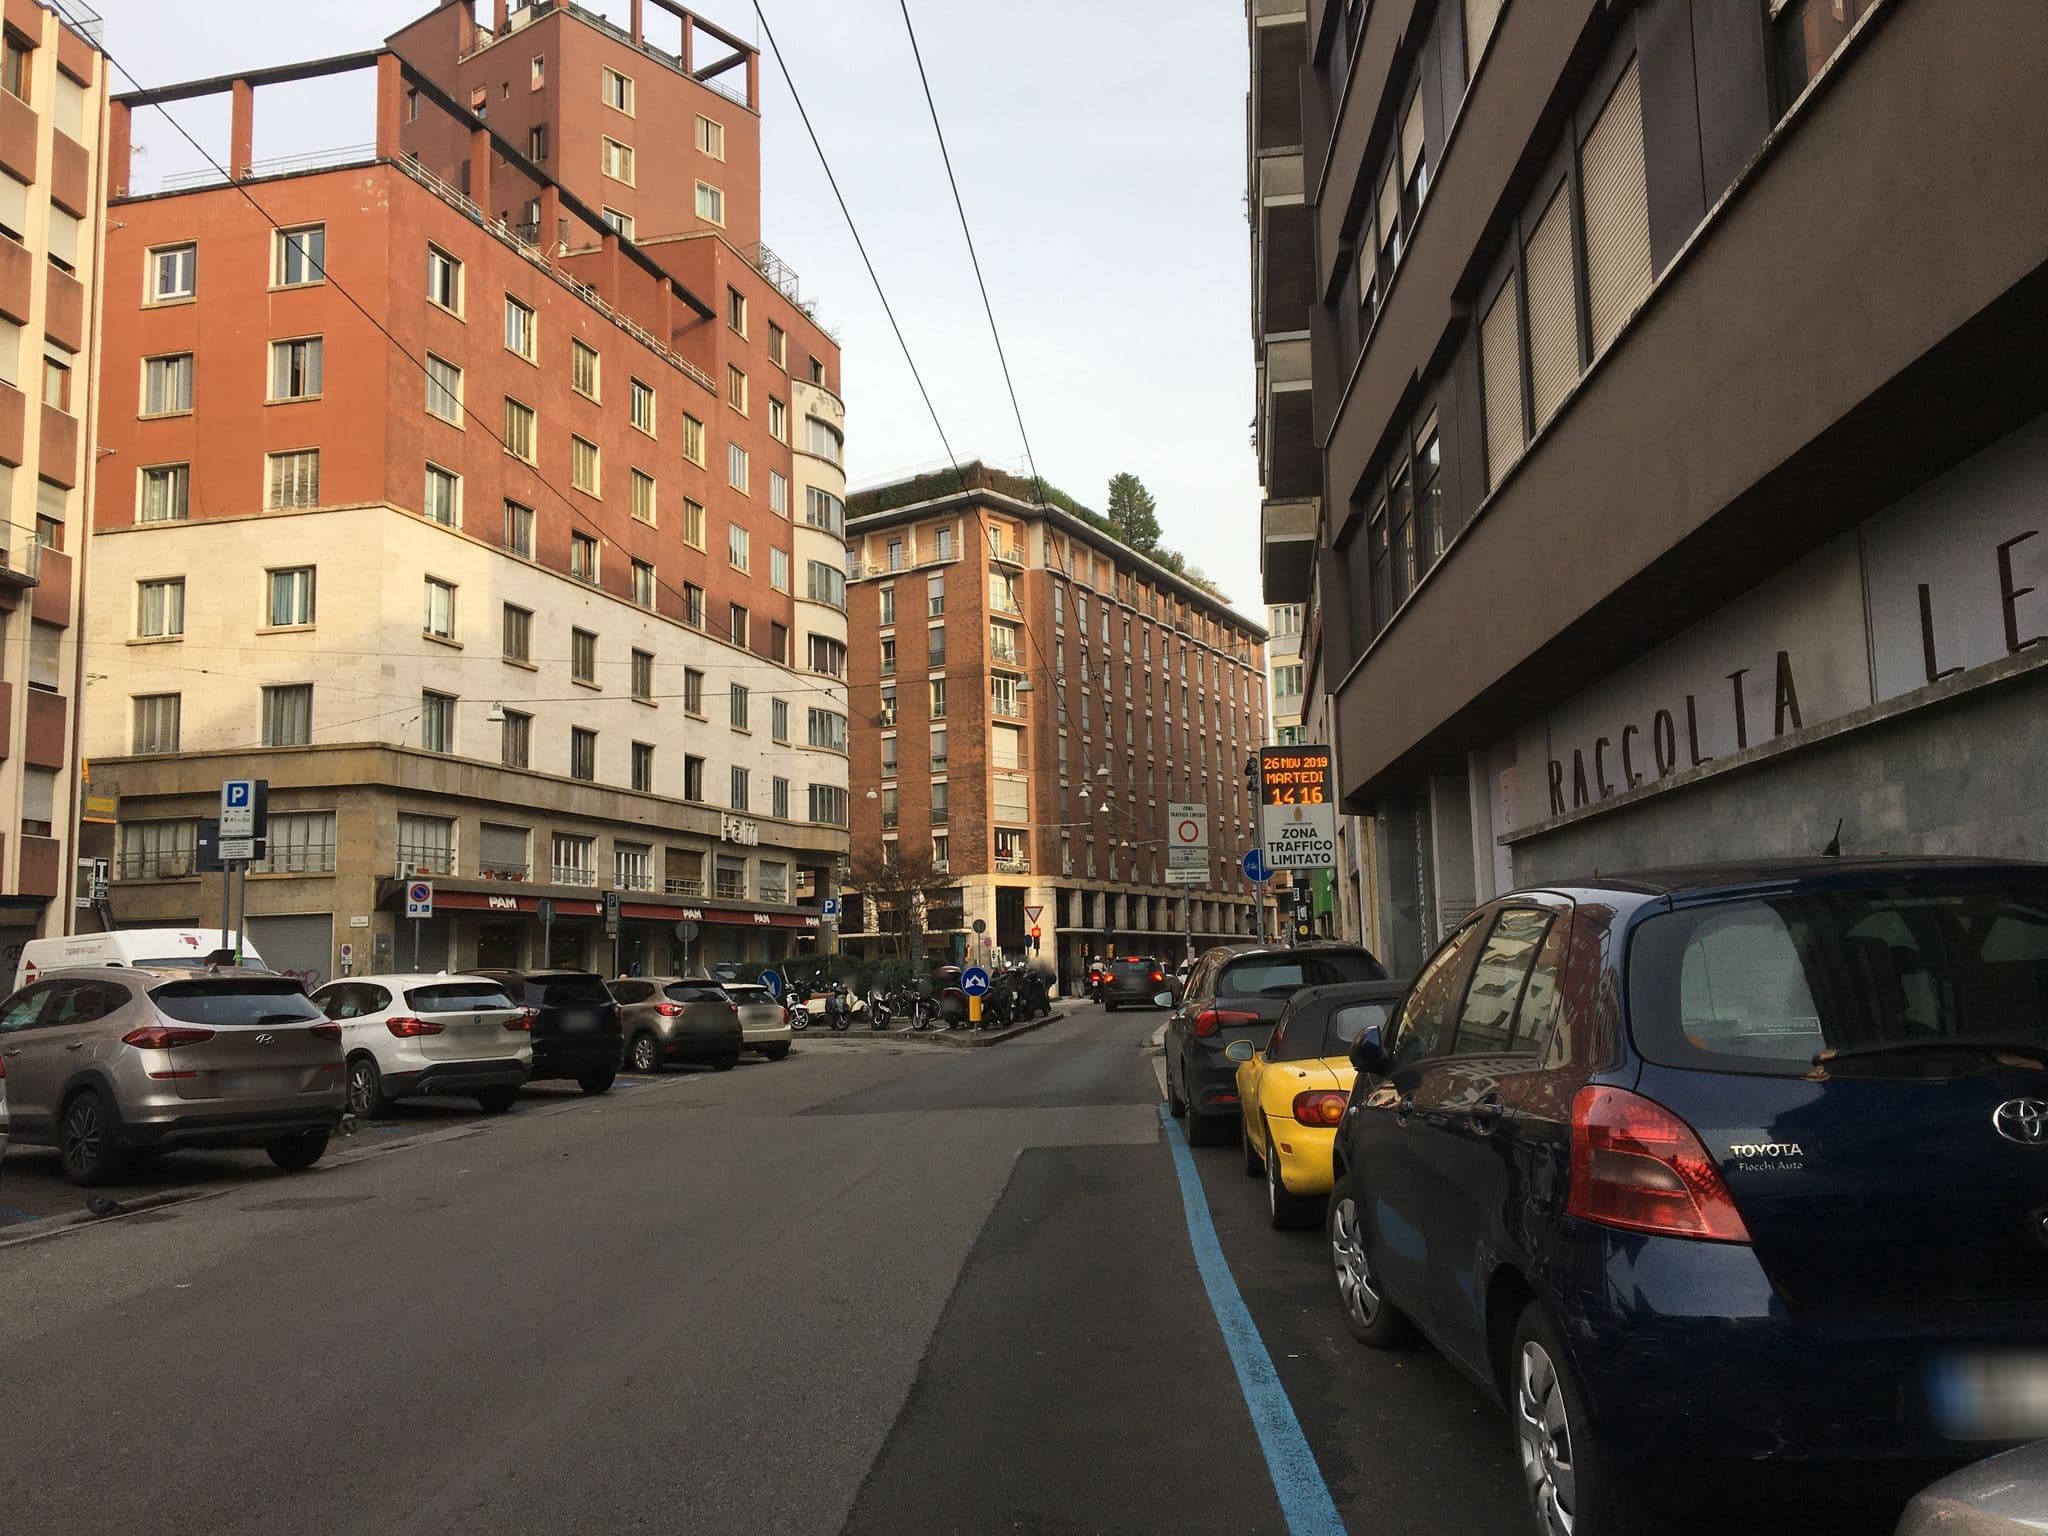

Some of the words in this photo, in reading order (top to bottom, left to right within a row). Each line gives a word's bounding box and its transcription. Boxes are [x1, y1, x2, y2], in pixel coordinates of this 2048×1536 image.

[1547, 650, 1803, 816] RACCOLTA
[1264, 757, 1280, 770] 26
[1281, 758, 1301, 769] NOV
[1303, 757, 1328, 769] 2019
[1266, 771, 1324, 785] MARTEDI
[231, 786, 244, 804] P
[1281, 828, 1318, 839] ZONA
[1267, 840, 1333, 853] TRAFFICO
[1271, 853, 1331, 865] LIMITATO
[489, 896, 517, 909] PAM
[824, 900, 834, 913] P
[682, 909, 703, 919] PAM
[754, 913, 771, 924] PAM
[1730, 1143, 1804, 1158] TOYOTA
[1777, 1161, 1803, 1170] Auto
